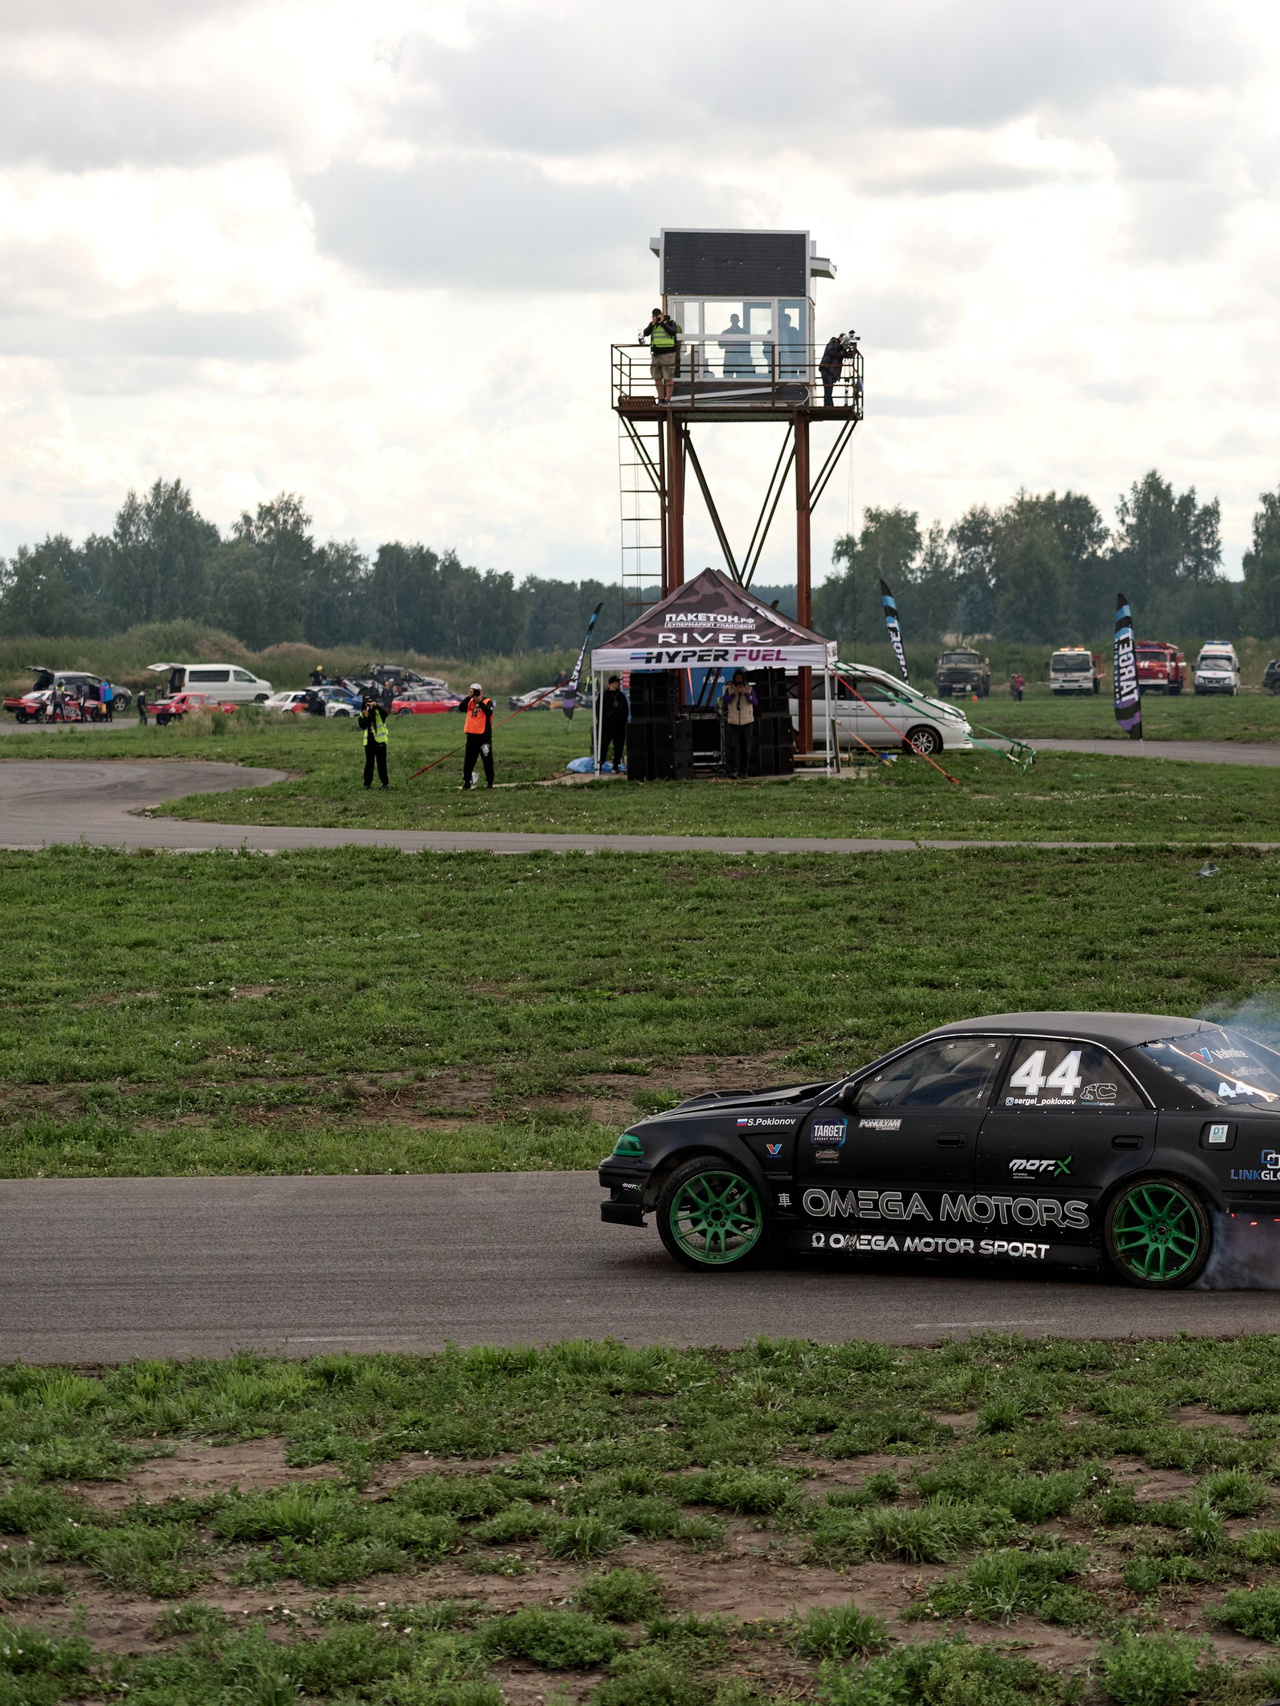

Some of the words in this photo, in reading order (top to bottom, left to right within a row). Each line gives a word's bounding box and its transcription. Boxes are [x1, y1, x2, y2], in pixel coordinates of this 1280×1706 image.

[658, 632, 773, 643] RIVER
[643, 650, 730, 664] HYPER
[733, 649, 787, 662] FUEL
[1009, 1050, 1082, 1096] 44
[1217, 1081, 1254, 1099] 44
[747, 1118, 797, 1126] S.Poklonov
[814, 1125, 845, 1137] TARGET
[1213, 1126, 1225, 1135] D1
[1009, 1155, 1072, 1178] MOT-X
[778, 1193, 792, 1207] 車
[802, 1188, 933, 1221] OMEGA
[939, 1193, 1090, 1229] MOTORS
[829, 1233, 899, 1251] OMEGA
[903, 1236, 975, 1254] MOTOR
[979, 1239, 1050, 1259] SPORT
